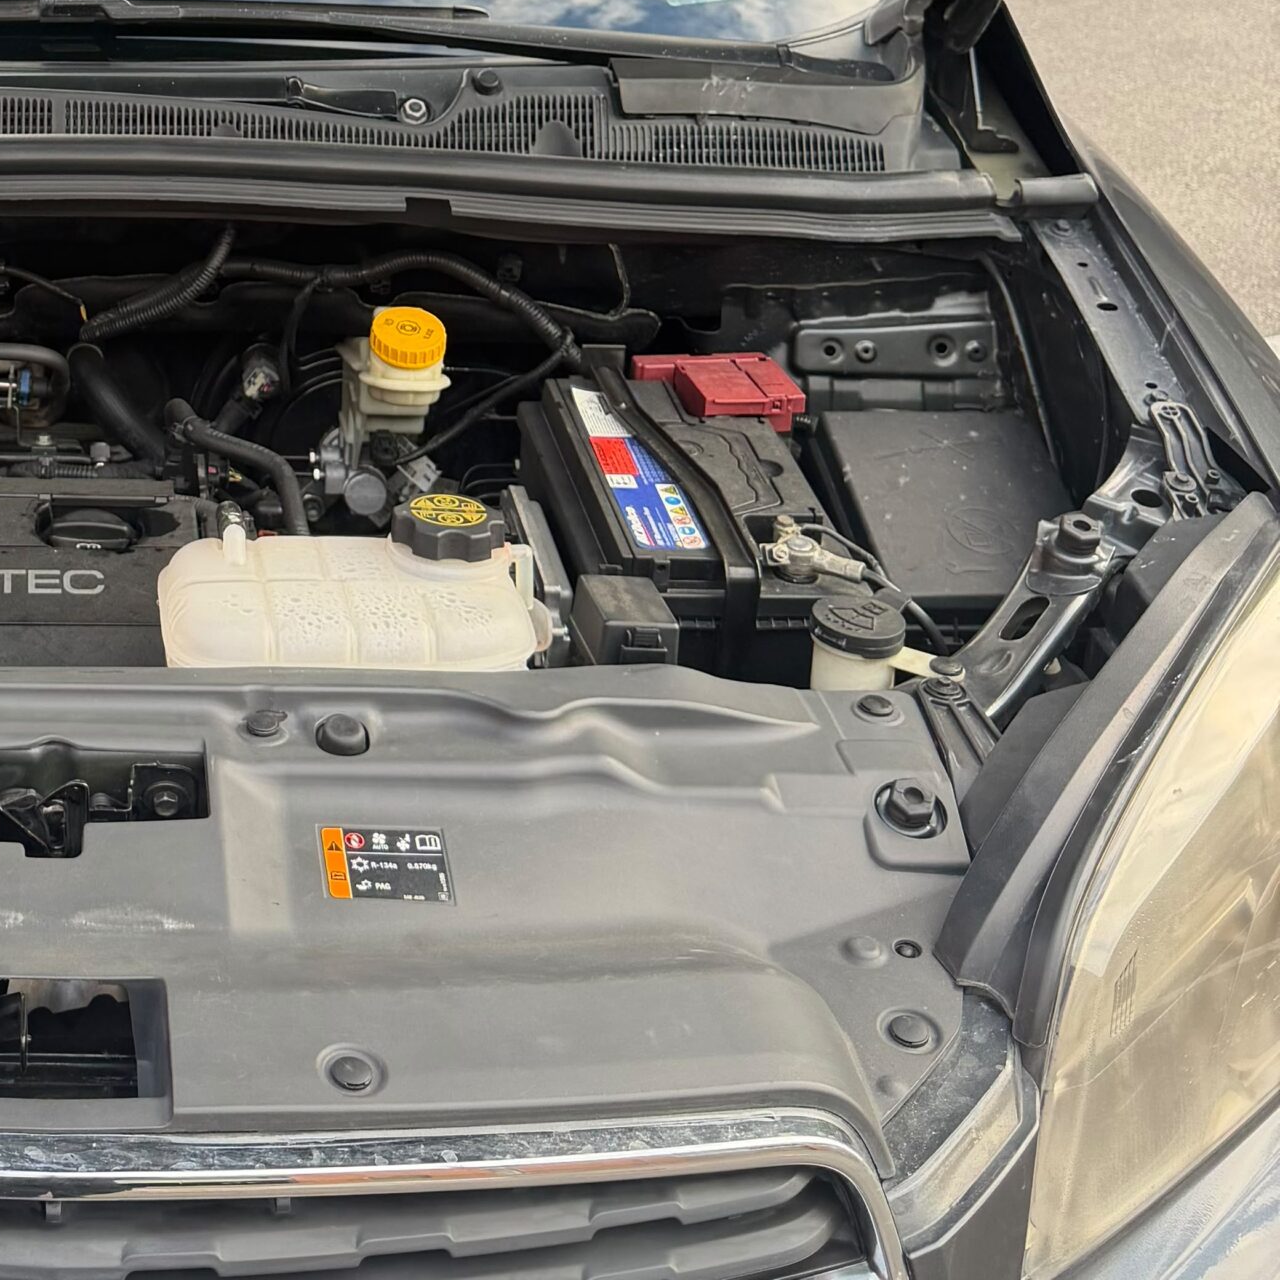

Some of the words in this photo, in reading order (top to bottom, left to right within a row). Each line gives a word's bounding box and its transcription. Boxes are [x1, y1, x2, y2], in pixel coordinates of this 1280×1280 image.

[372, 843, 389, 851] AUTO
[370, 861, 398, 870] R-134a
[375, 882, 391, 891] PAG
